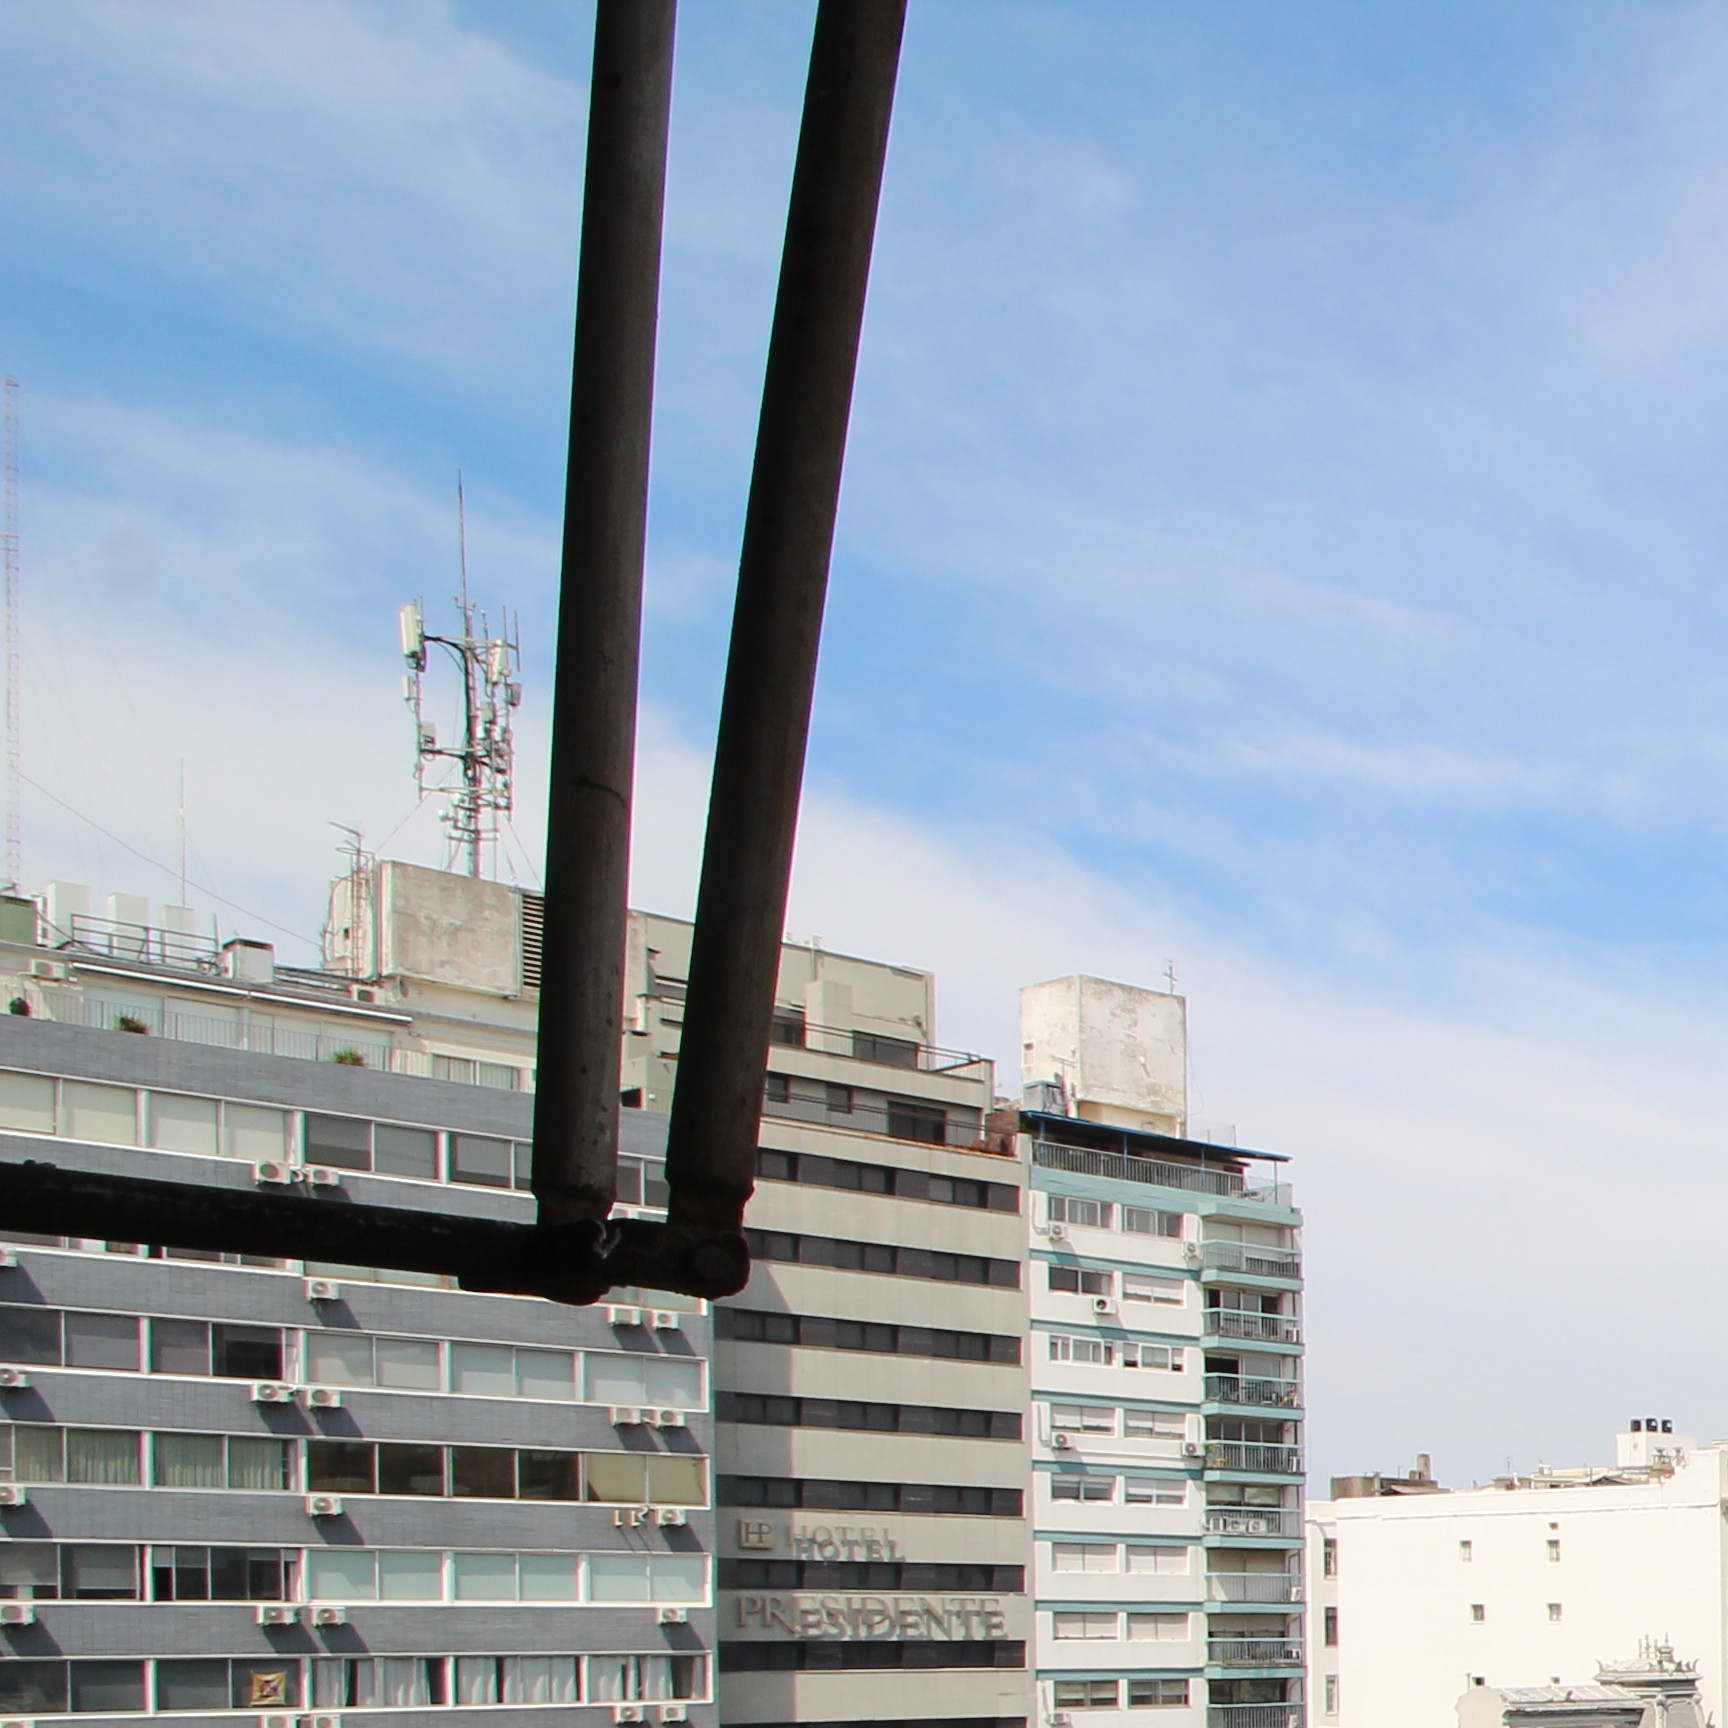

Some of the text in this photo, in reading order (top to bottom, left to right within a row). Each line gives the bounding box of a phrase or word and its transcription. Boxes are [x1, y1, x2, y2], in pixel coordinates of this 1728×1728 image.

[743, 1521, 773, 1544] HP
[788, 1525, 899, 1550] HOTEL
[737, 1594, 1004, 1638] PRESIDENTE
